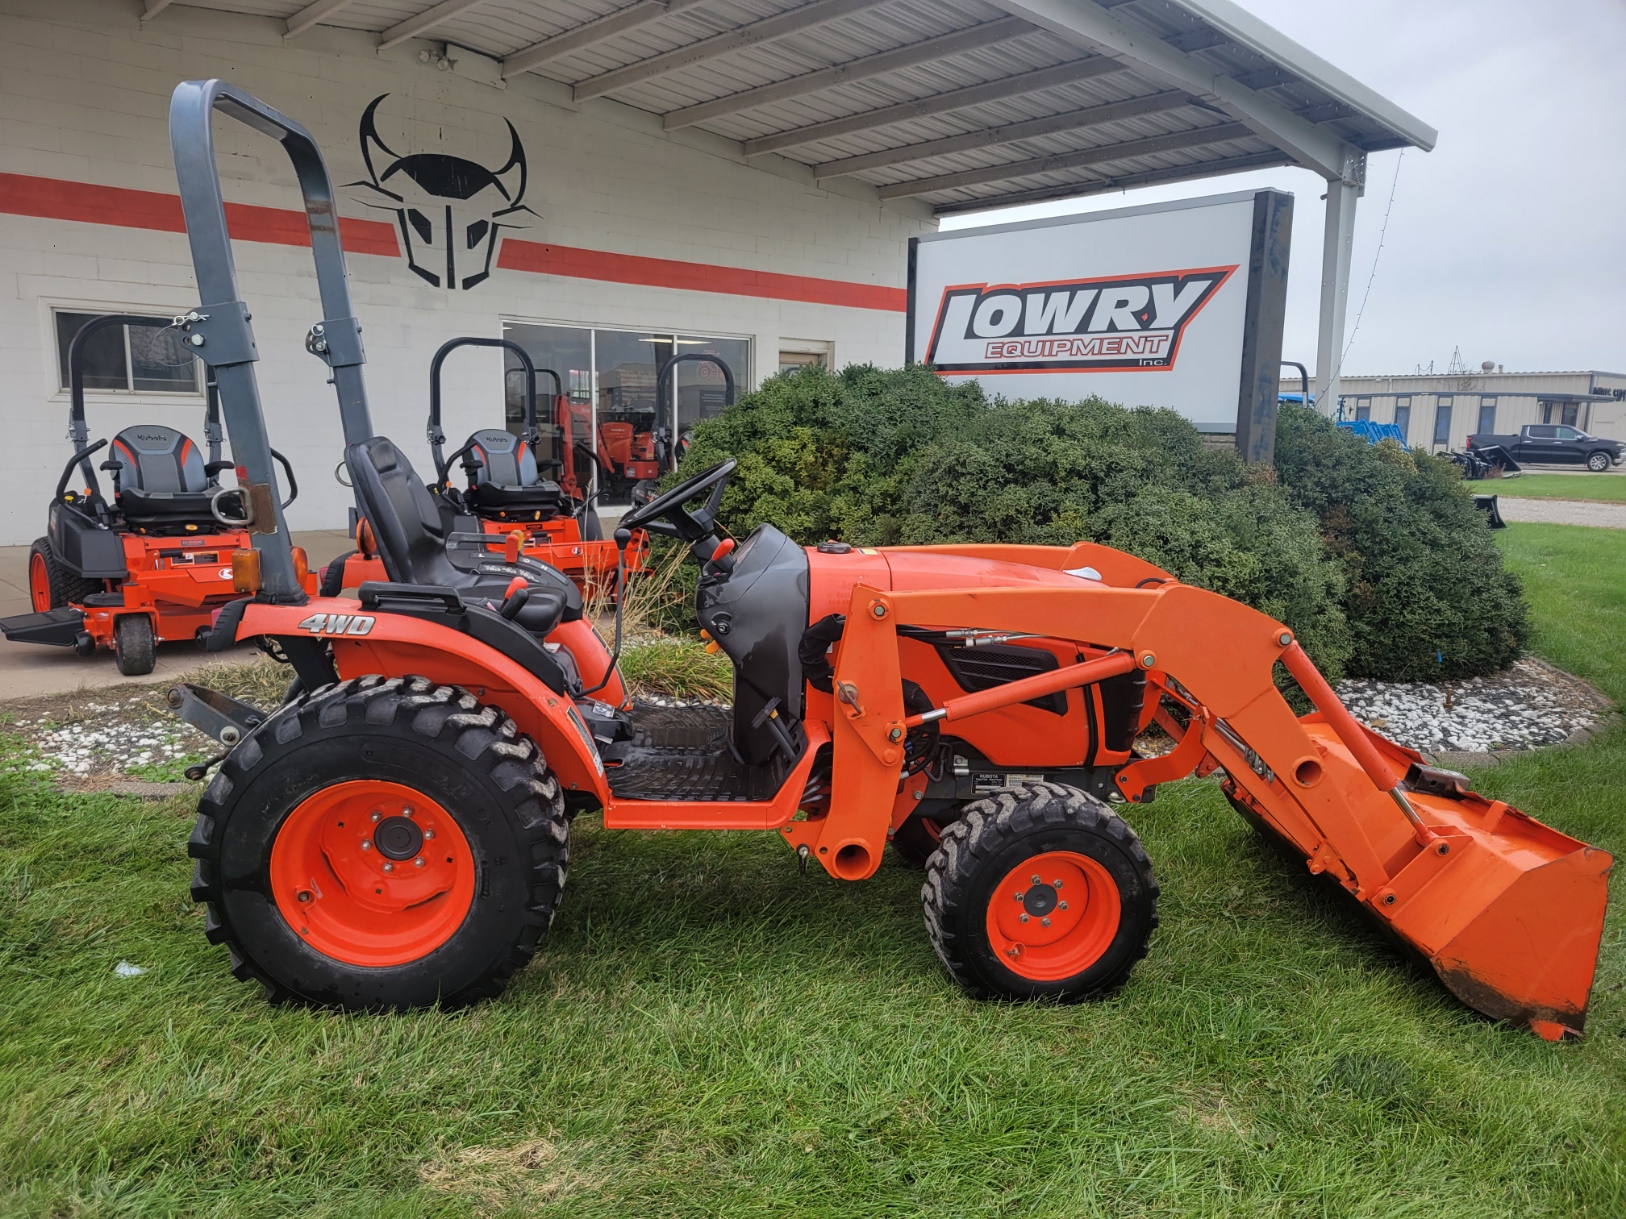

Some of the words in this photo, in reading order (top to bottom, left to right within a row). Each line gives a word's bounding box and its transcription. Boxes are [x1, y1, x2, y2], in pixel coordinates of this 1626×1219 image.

[936, 279, 1213, 348] LOWRY
[985, 334, 1170, 359] EQUIPMENT
[298, 613, 376, 636] 4WD
